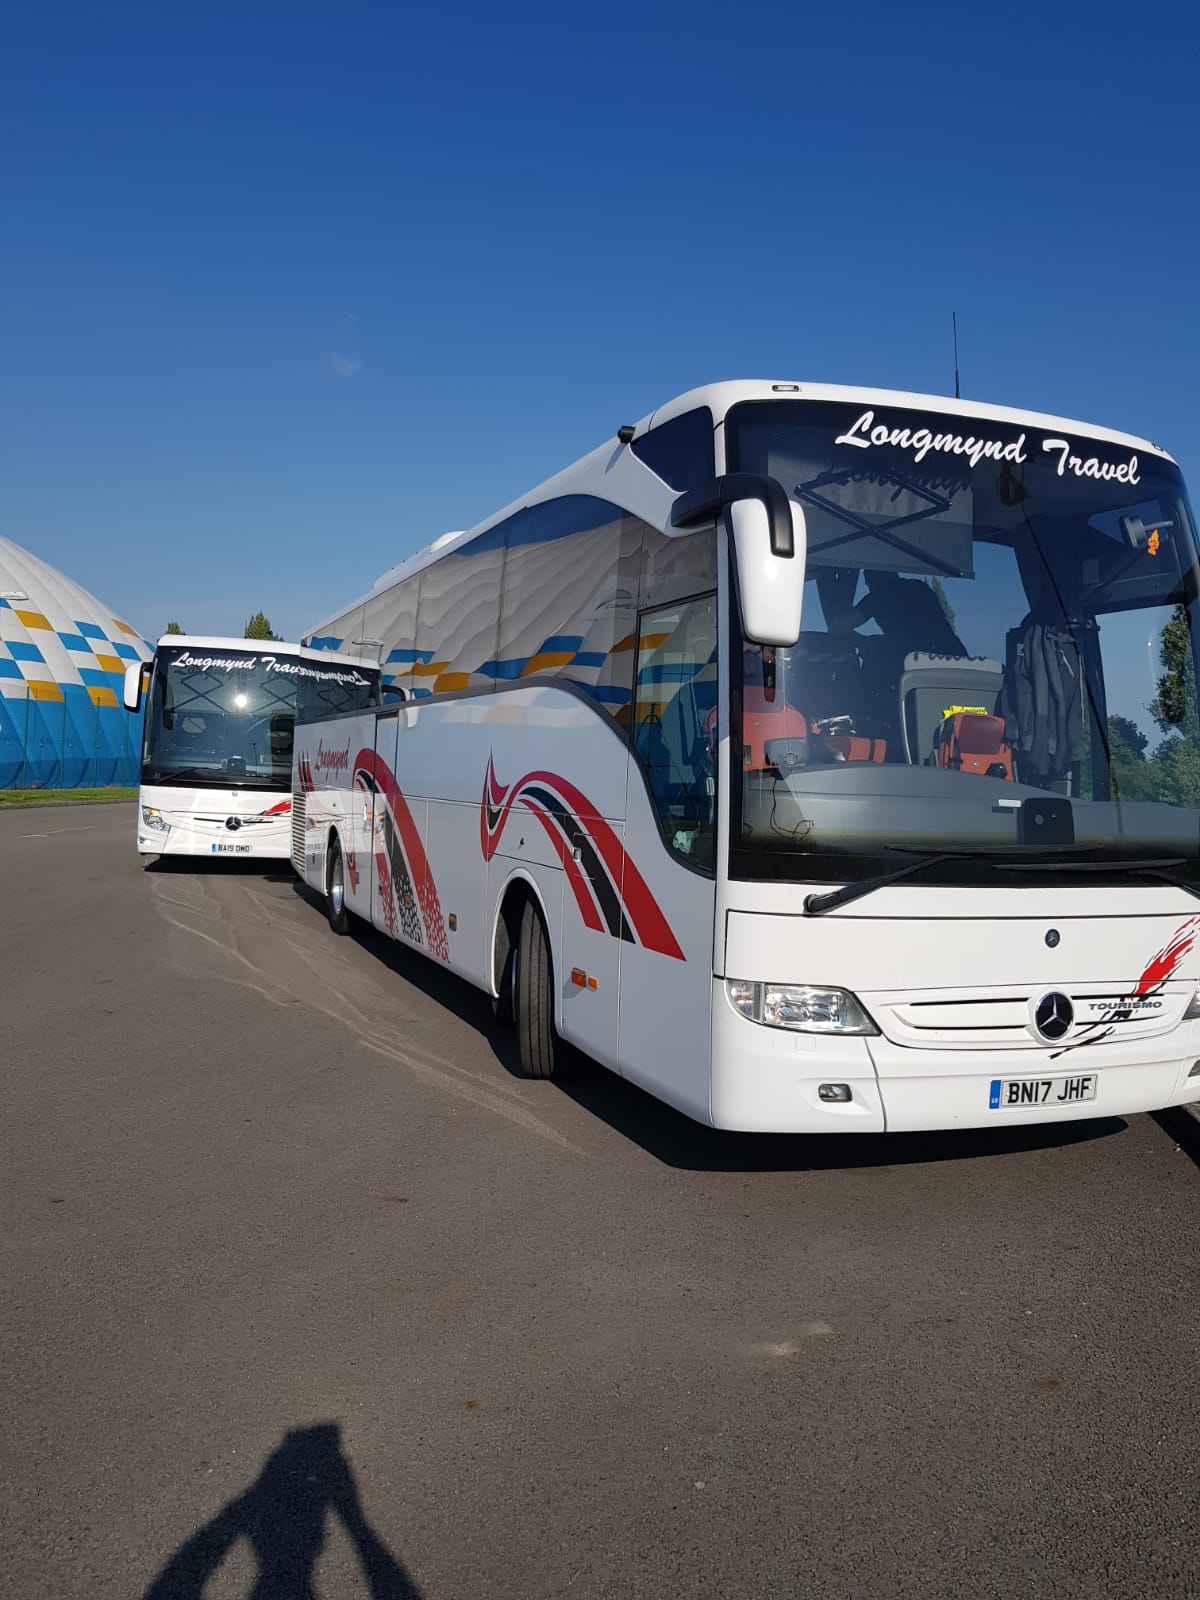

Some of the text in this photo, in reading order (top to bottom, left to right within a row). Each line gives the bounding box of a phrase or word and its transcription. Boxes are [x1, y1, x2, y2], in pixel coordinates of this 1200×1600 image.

[834, 411, 1141, 485] Longmynd Travel
[171, 652, 300, 673] Longmynd Trav
[1088, 1001, 1163, 1011] TOURISMO
[1007, 1077, 1092, 1103] BN17 JHF
